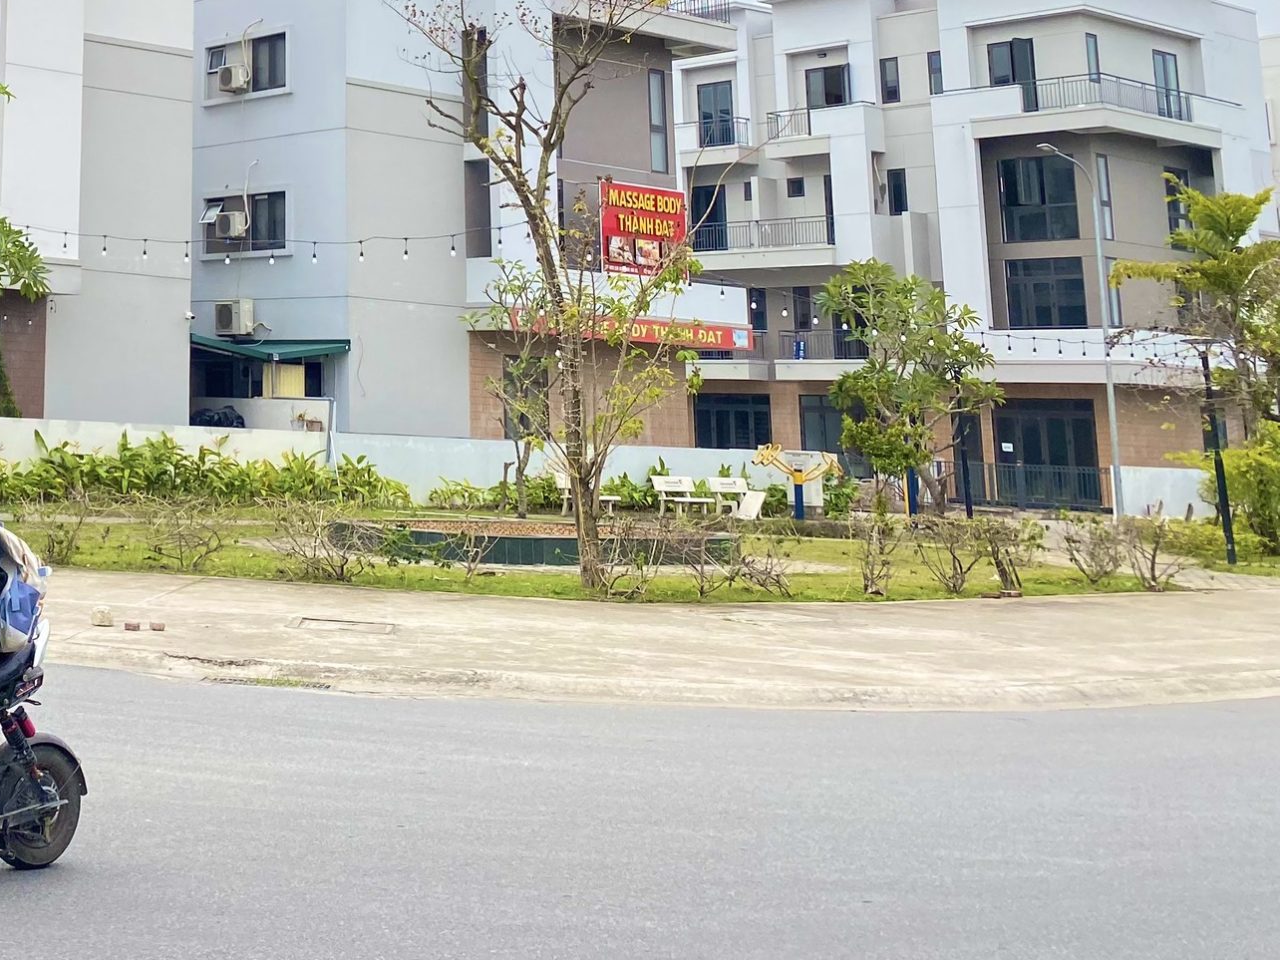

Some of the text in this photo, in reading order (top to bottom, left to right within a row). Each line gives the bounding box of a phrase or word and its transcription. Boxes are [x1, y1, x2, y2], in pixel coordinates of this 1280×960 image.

[609, 188, 681, 215] MASSAGE BODY
[698, 329, 723, 346] ĐẠT
